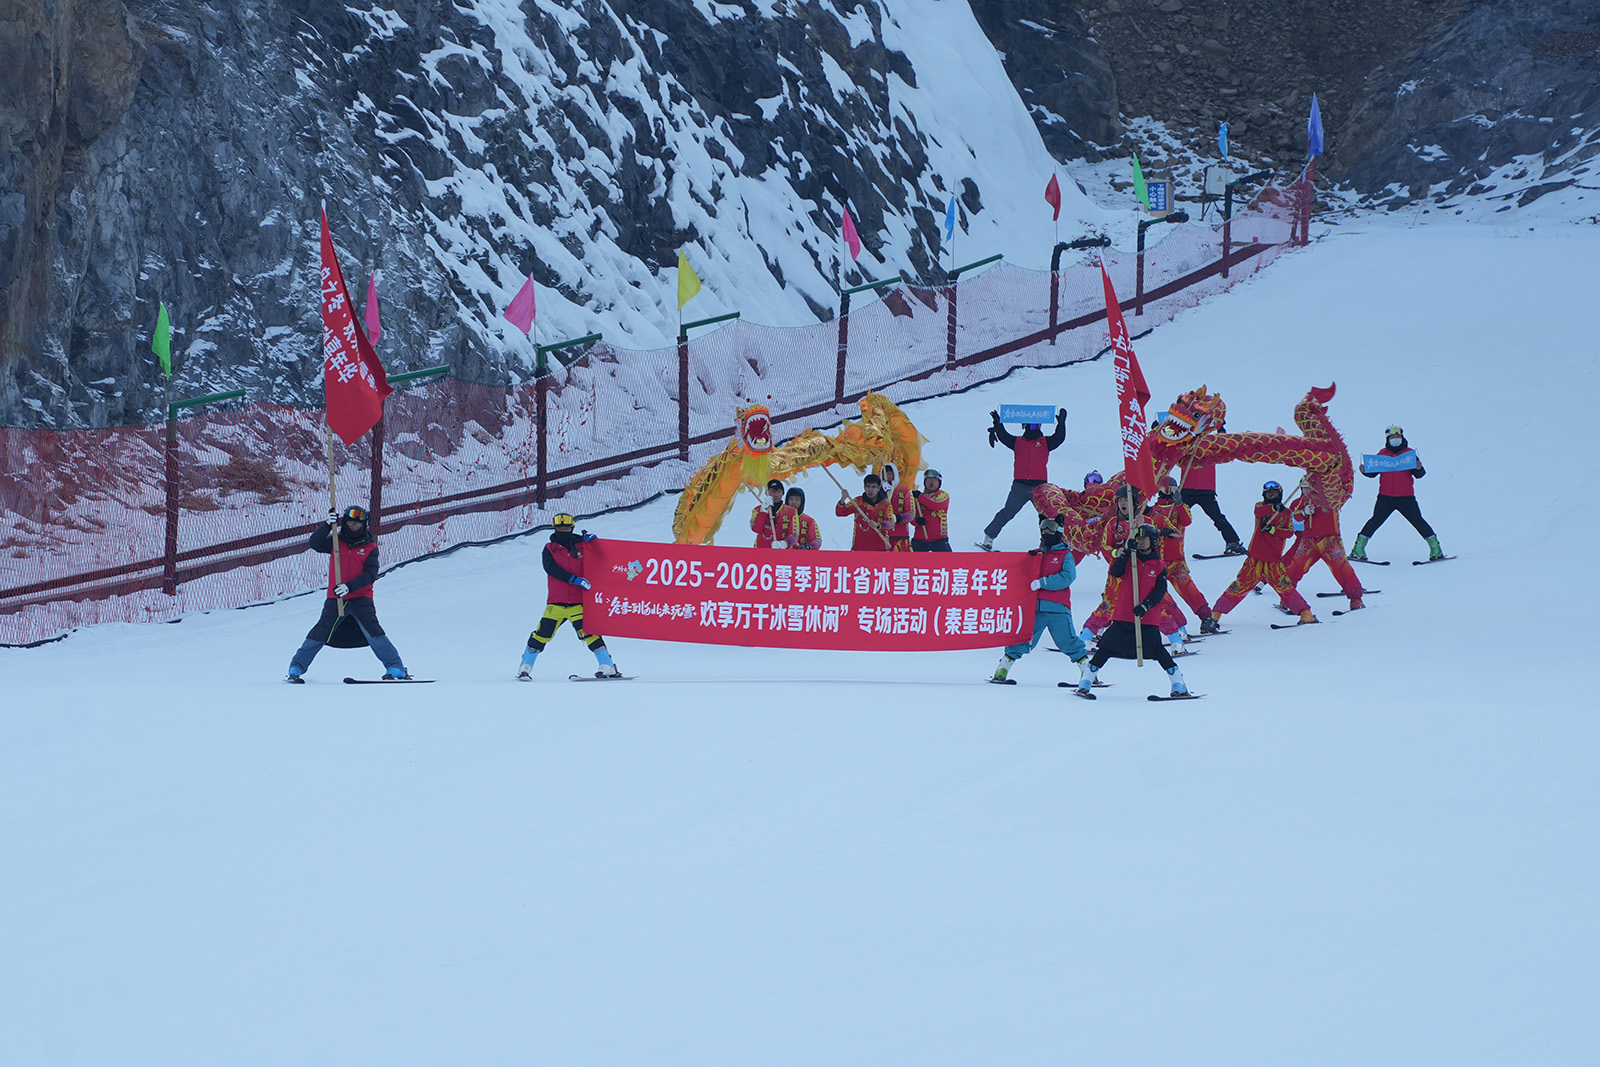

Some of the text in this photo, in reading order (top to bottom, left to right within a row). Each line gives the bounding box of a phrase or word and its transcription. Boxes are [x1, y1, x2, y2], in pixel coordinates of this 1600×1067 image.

[645, 558, 1008, 596] 2025-2026雪季河北省冰雪运动嘉年华
